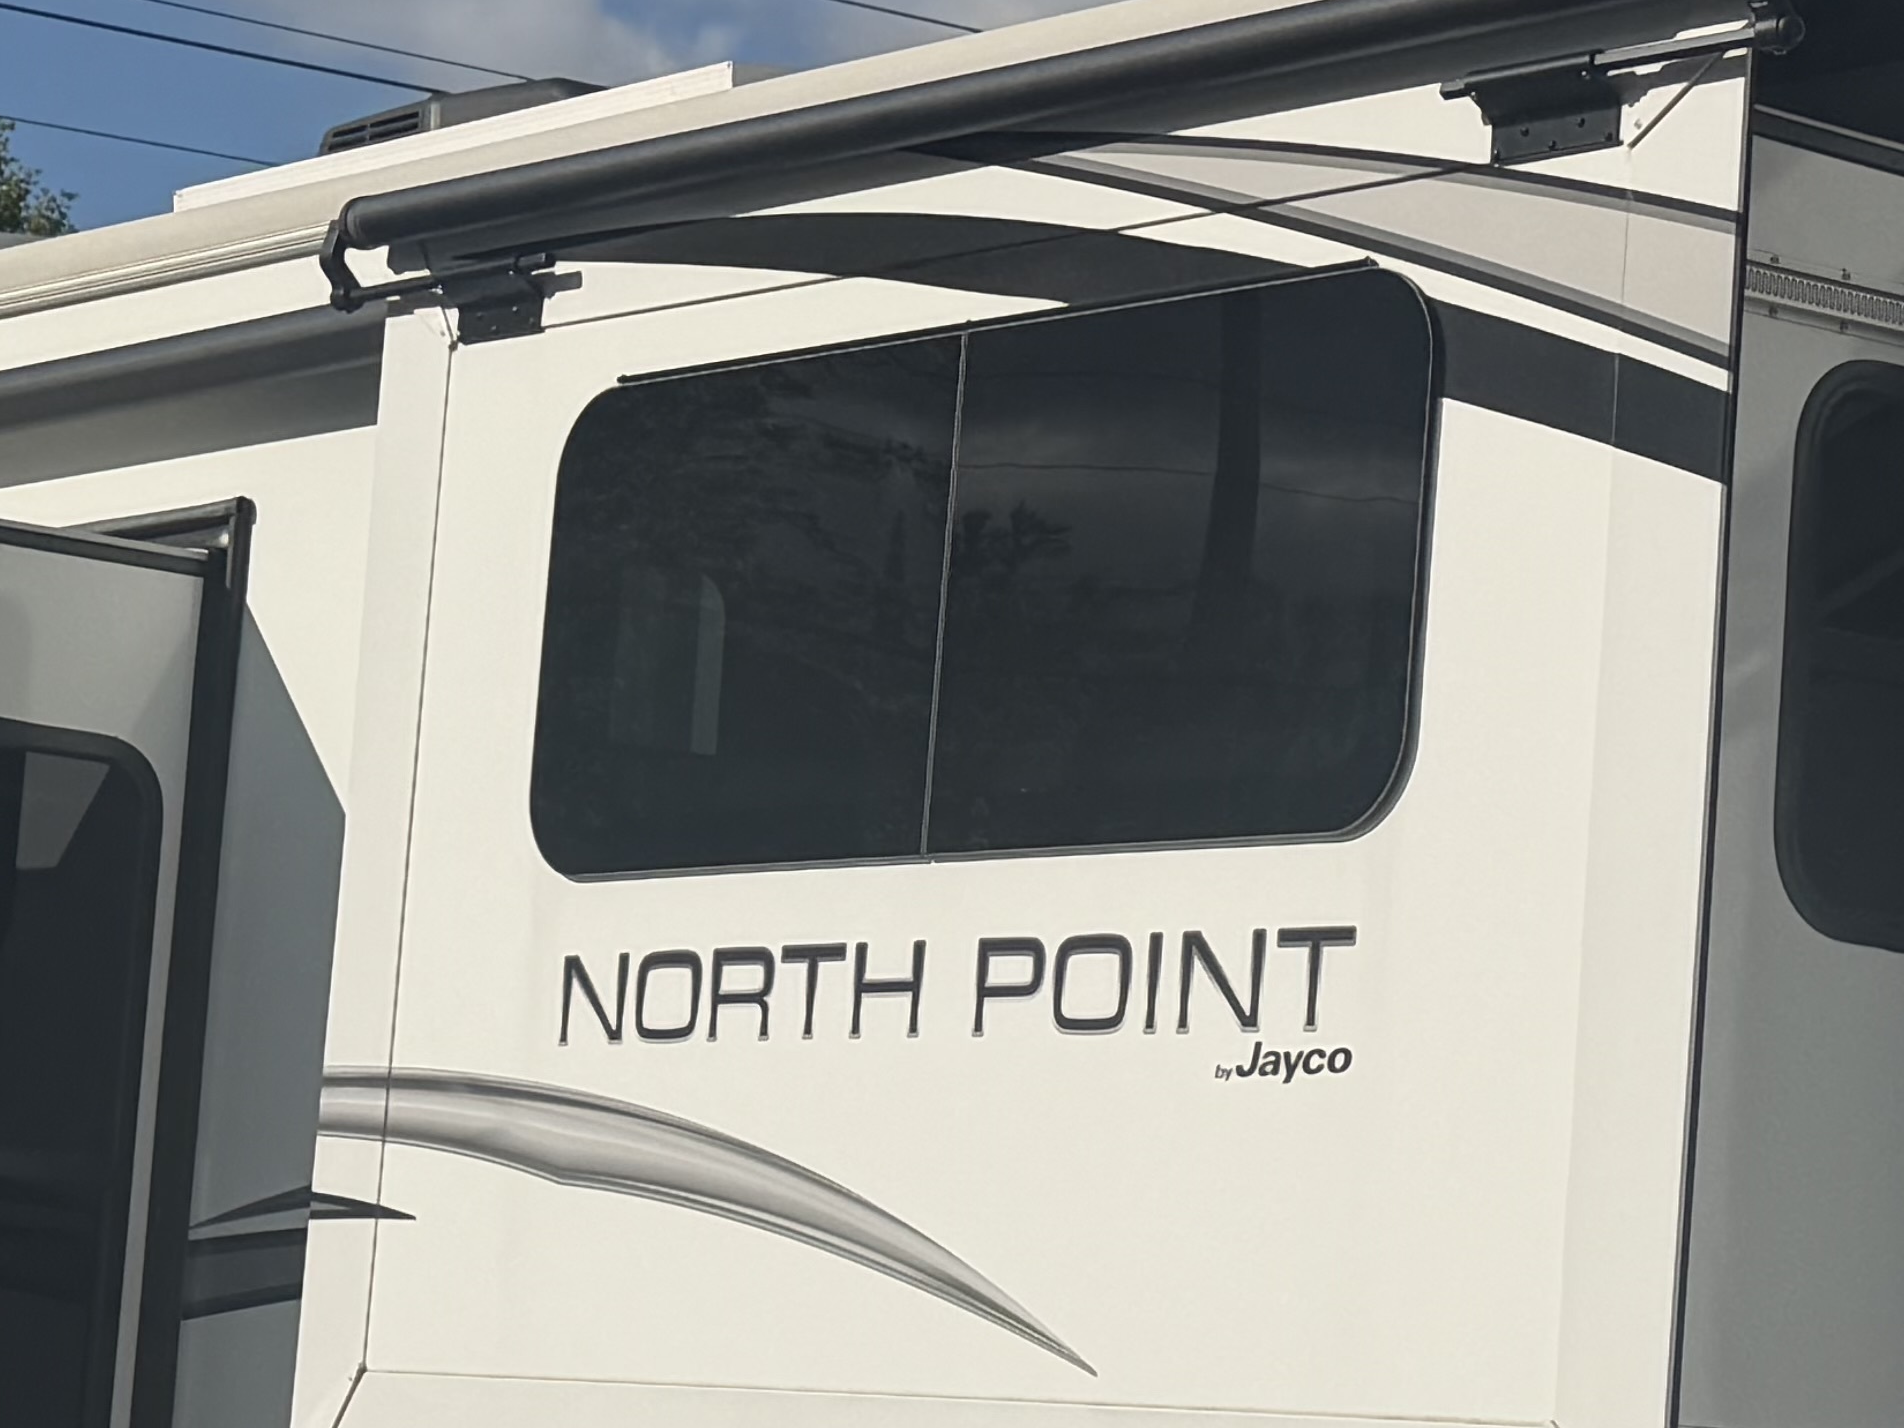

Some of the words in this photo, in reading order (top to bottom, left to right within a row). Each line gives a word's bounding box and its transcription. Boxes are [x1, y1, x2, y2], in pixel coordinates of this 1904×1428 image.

[559, 939, 927, 1046] NORTH
[972, 925, 1357, 1037] POINT
[1214, 1064, 1232, 1081] by
[1235, 1041, 1353, 1084] Jayco
